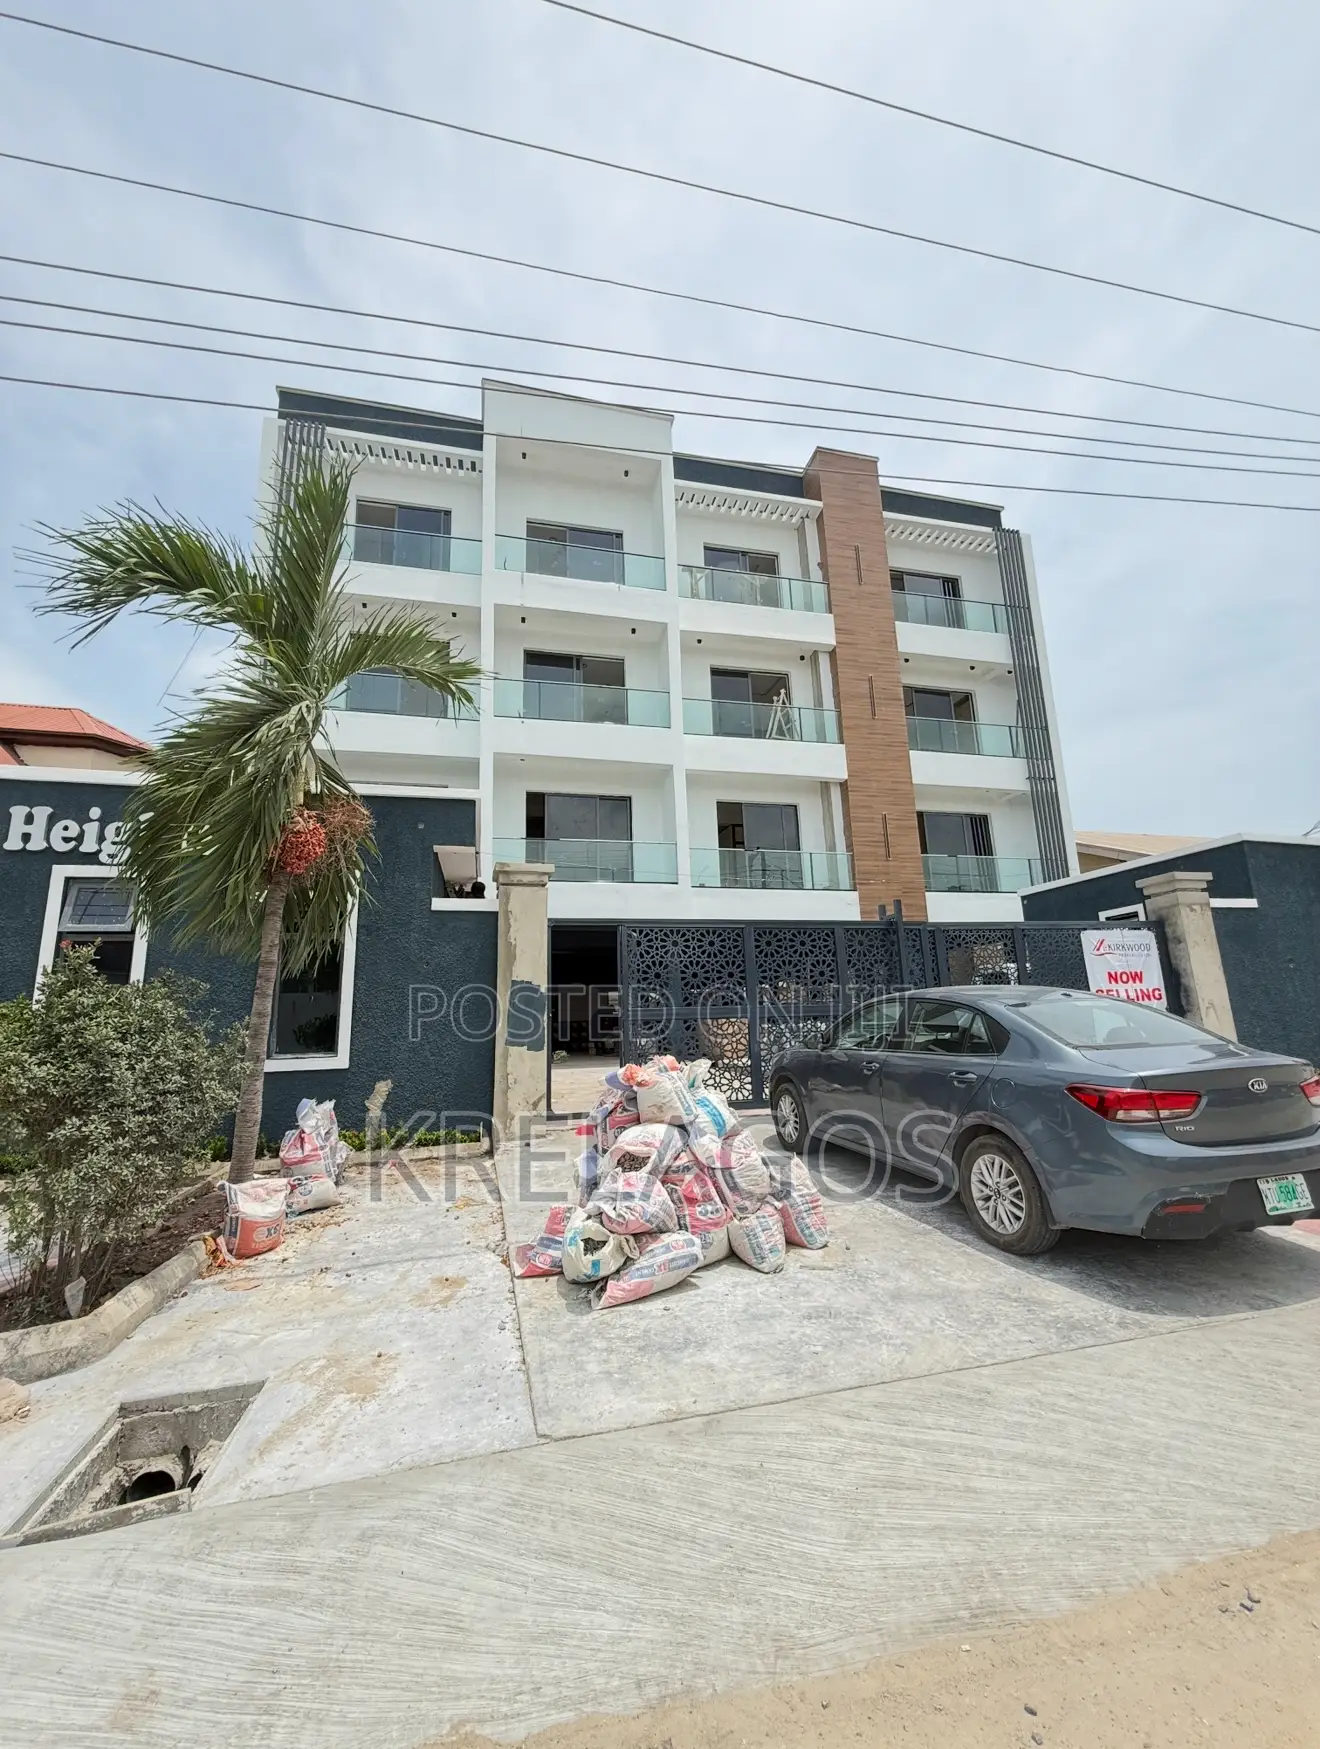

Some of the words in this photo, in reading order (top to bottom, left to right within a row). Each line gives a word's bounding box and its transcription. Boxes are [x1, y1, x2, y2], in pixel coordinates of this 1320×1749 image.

[3, 805, 155, 865] Heig
[1107, 943, 1151, 953] KIRKWOOD
[1107, 970, 1143, 985] NOW
[1253, 1081, 1268, 1090] KIA
